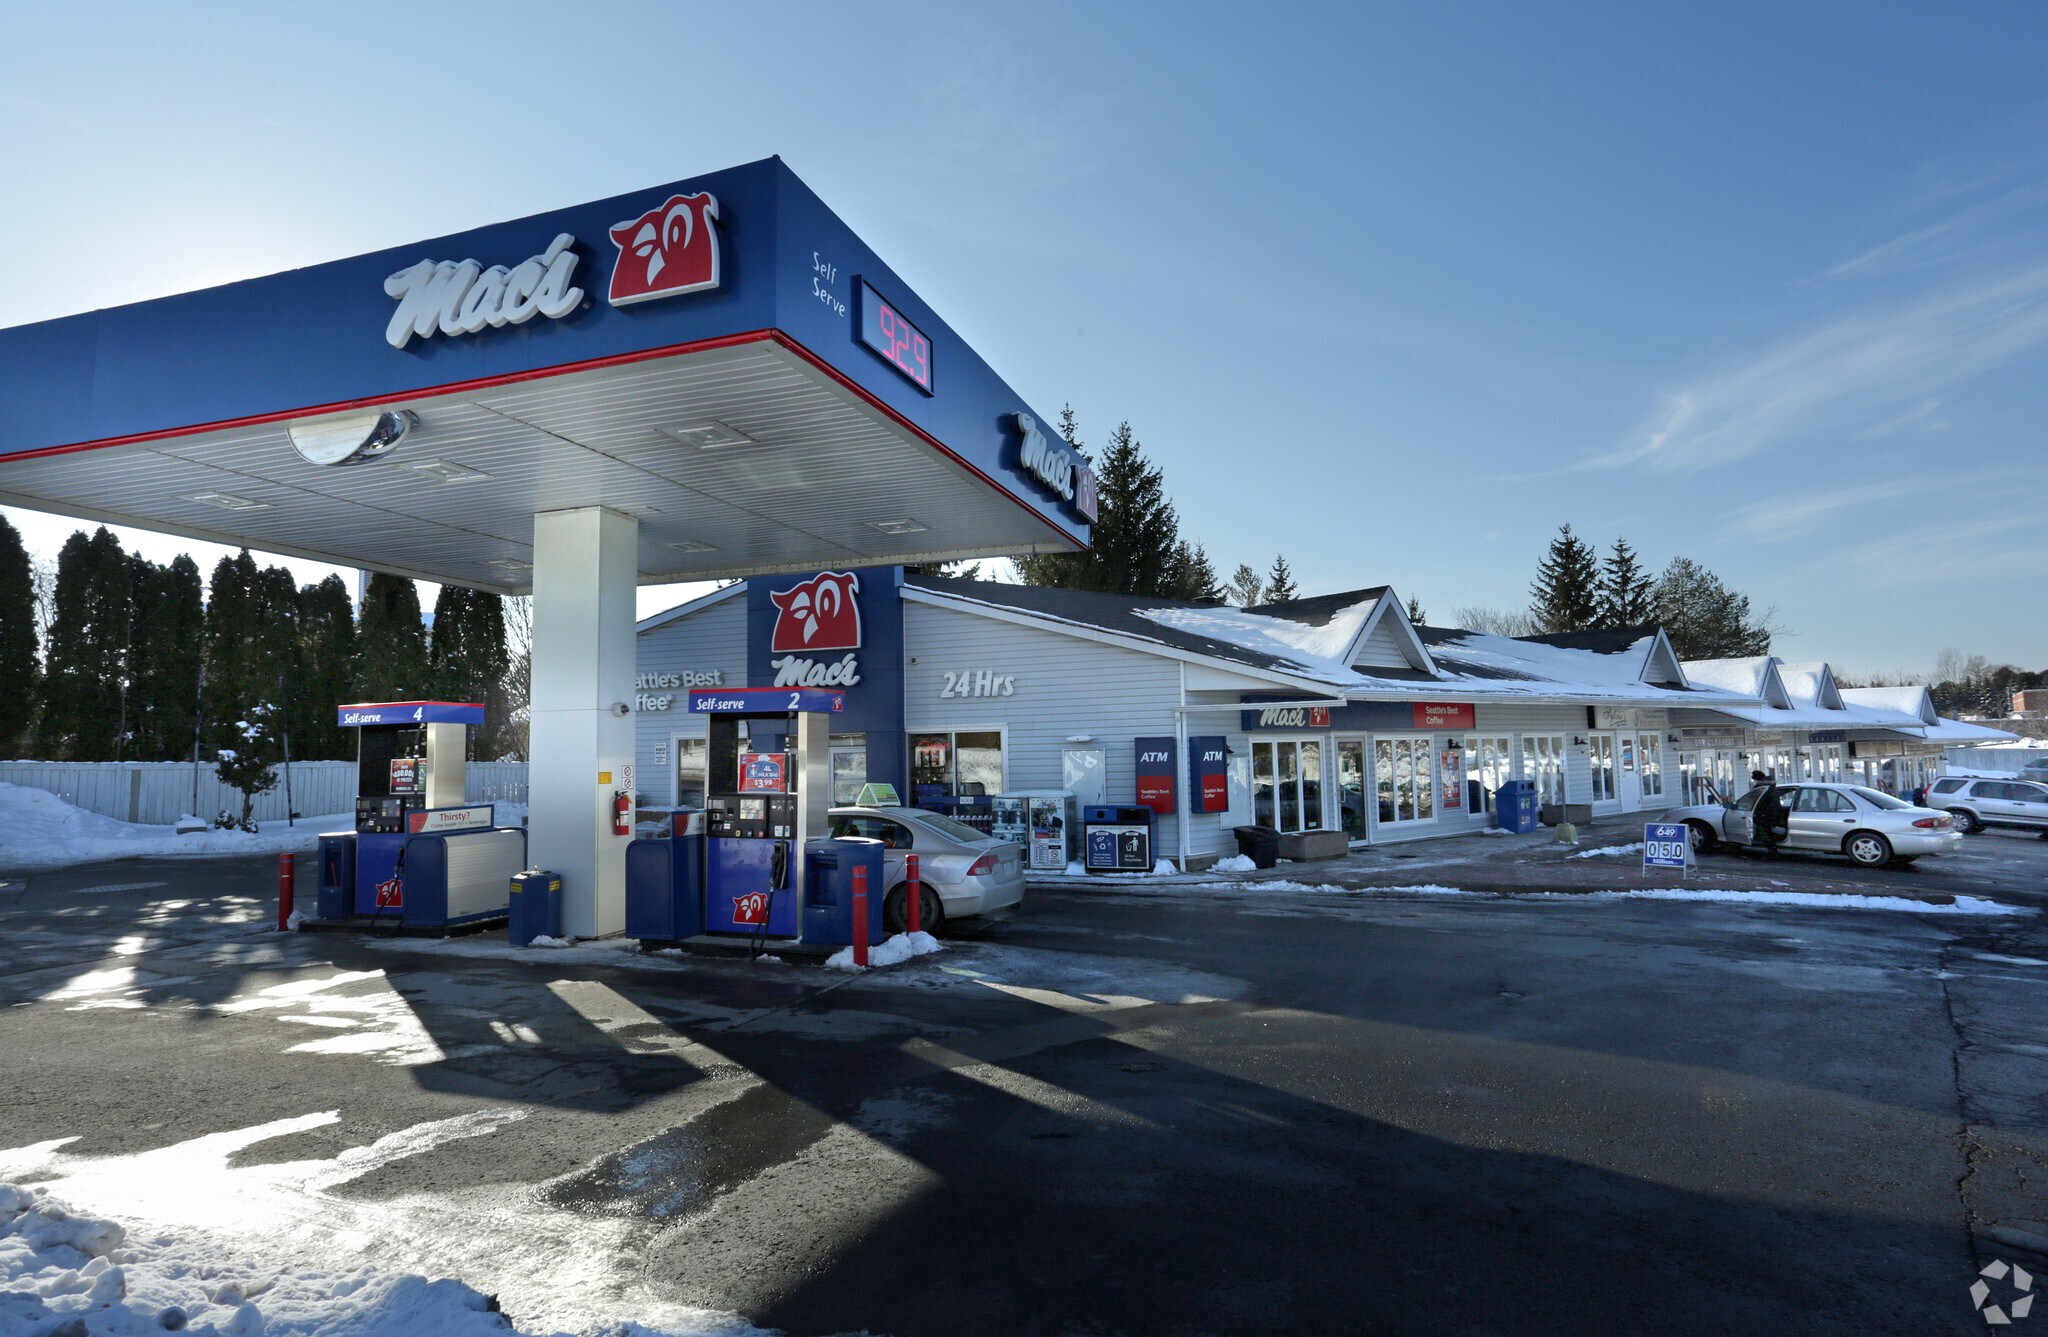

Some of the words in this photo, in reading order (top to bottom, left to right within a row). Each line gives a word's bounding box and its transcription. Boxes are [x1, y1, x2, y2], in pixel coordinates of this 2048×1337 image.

[812, 252, 838, 284] Self
[384, 233, 584, 349] Mac's
[811, 277, 846, 317] Serve
[1017, 411, 1074, 501] Mac's
[682, 669, 722, 688] Best
[771, 653, 861, 687] Mac's
[941, 671, 971, 699] 24
[974, 670, 1015, 697] Hrs
[696, 698, 745, 710] Self-serve
[788, 692, 800, 709] 2
[344, 713, 382, 724] Self-serve
[413, 706, 423, 721] 4
[1259, 707, 1306, 727] Mac's
[1426, 716, 1444, 725] Coffee
[1140, 752, 1169, 763] ATM
[1202, 751, 1223, 762] ATM
[440, 811, 470, 821] Thirsty?
